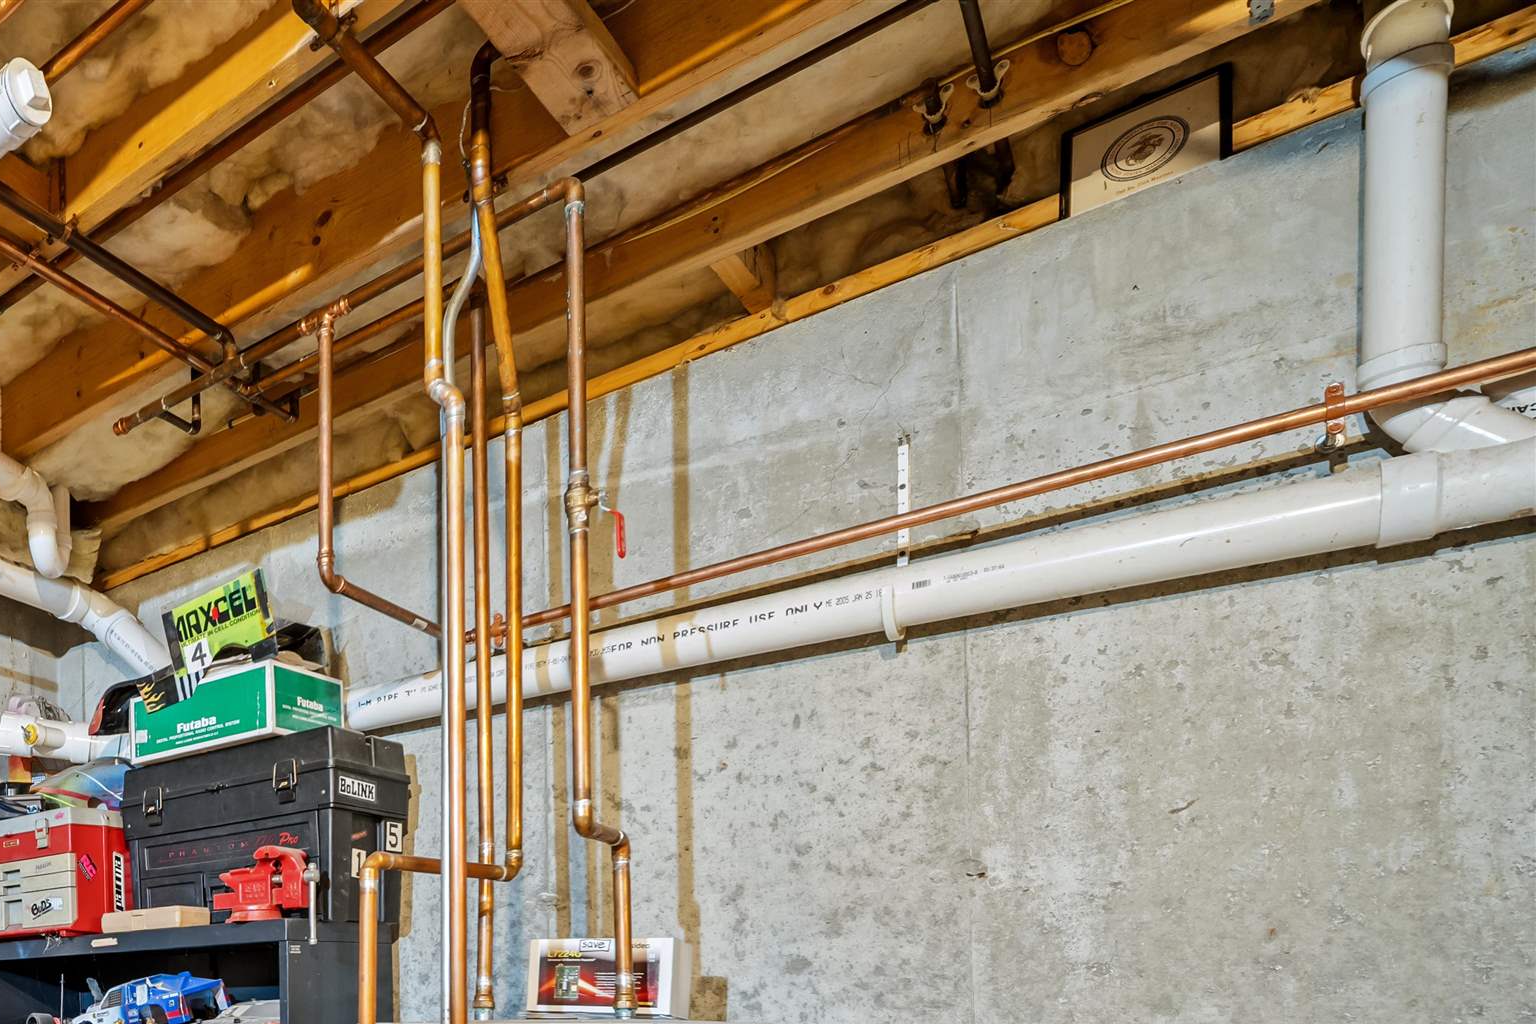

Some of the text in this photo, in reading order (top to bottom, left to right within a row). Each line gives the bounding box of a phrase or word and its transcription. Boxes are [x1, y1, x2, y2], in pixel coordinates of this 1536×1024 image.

[214, 624, 229, 635] CELL
[229, 609, 260, 627] CONDITION
[190, 641, 207, 667] 4
[297, 696, 324, 712] Futaba
[176, 715, 217, 734] Futaba
[279, 831, 300, 847] Pro
[388, 823, 400, 849] 5
[353, 851, 363, 877] 1
[581, 940, 606, 949] save
